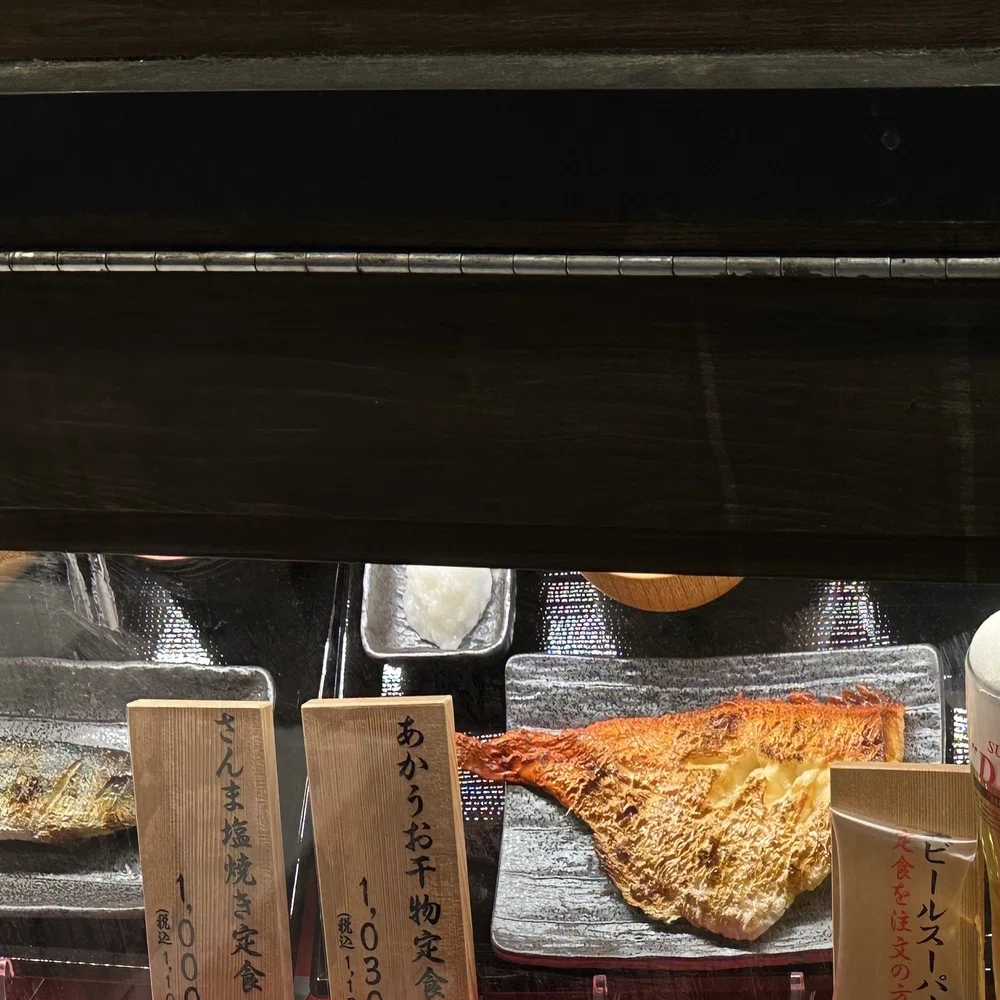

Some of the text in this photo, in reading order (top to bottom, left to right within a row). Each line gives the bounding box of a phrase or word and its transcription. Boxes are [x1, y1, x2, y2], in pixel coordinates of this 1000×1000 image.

[214, 712, 265, 994] さんま塩焼き定食
[397, 715, 448, 1000] あかうお干物定食
